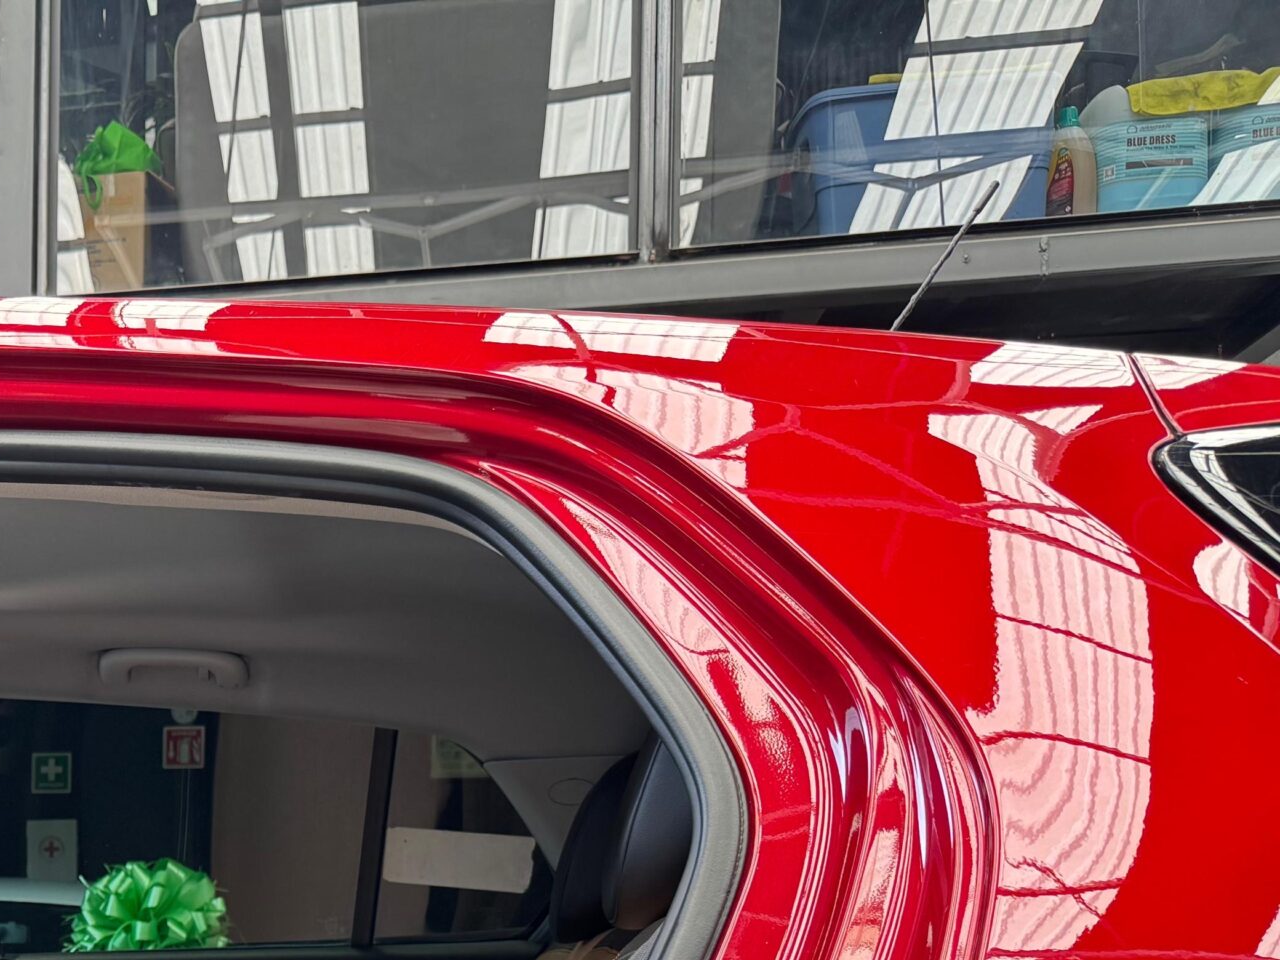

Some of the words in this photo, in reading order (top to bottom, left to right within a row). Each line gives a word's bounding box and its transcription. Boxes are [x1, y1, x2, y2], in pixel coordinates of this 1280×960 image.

[1252, 127, 1274, 138] BLUE
[1126, 136, 1147, 147] BLUE
[1149, 134, 1176, 146] DRESS
